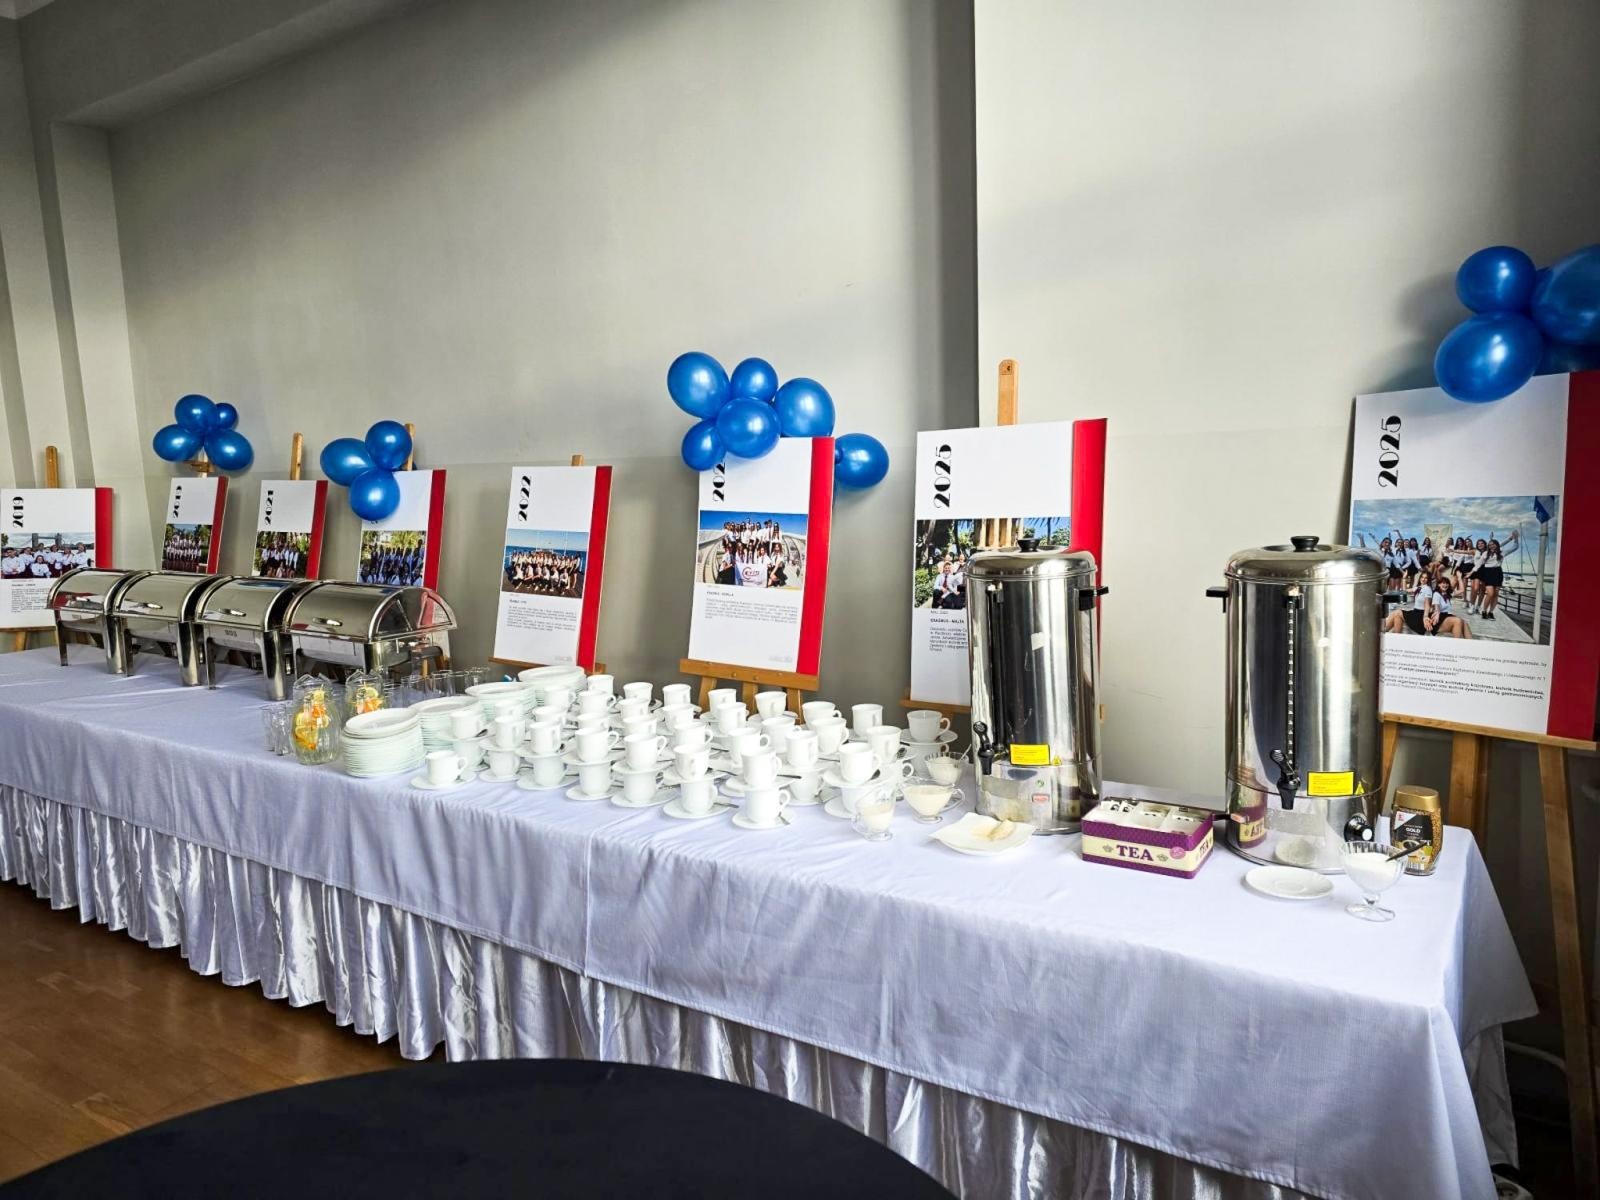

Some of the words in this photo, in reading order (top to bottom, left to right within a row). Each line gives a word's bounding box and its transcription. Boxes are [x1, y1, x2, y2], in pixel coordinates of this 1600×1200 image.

[1378, 415, 1401, 488] 2025
[712, 462, 726, 502] 202
[933, 444, 953, 509] 2025
[12, 496, 25, 528] 2019
[172, 484, 183, 519] 2019
[264, 489, 275, 526] 2021
[518, 475, 532, 522] 2022
[1116, 844, 1154, 862] TEA
